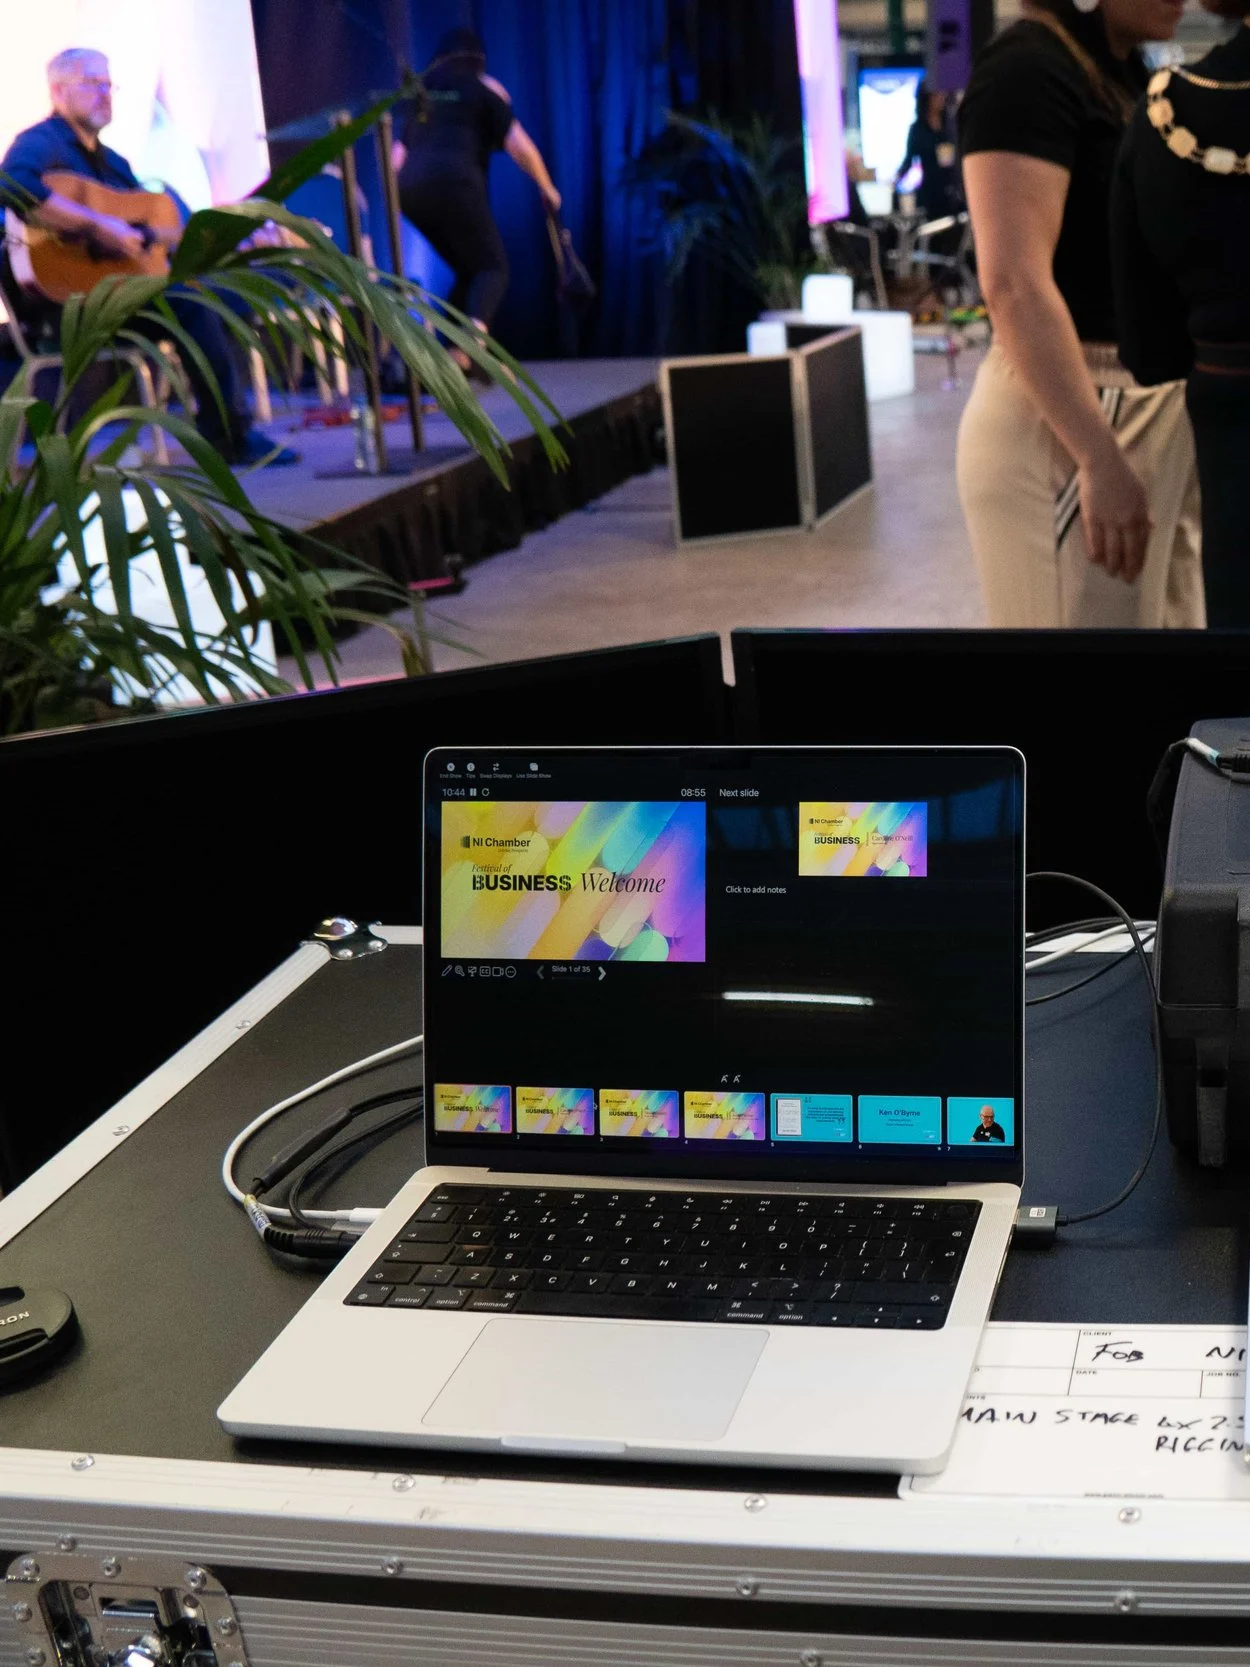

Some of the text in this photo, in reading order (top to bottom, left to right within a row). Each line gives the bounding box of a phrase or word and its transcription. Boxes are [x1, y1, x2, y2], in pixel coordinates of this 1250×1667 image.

[442, 788, 465, 797] 10:44
[680, 788, 706, 797] 08:55
[719, 788, 760, 797] Next slide
[472, 837, 531, 847] NI Chamber
[814, 836, 861, 845] BUSINESS
[471, 864, 513, 874] Festival of
[472, 871, 666, 893] BUSINESS Welcome
[725, 885, 787, 894] Click to add notes
[551, 965, 568, 973] Slide
[581, 965, 591, 973] 35
[893, 1109, 921, 1117] O'Byrne
[394, 1296, 420, 1304] control
[727, 1311, 764, 1319] command
[778, 1313, 803, 1321] option
[1054, 1409, 1140, 1426] STAGE
